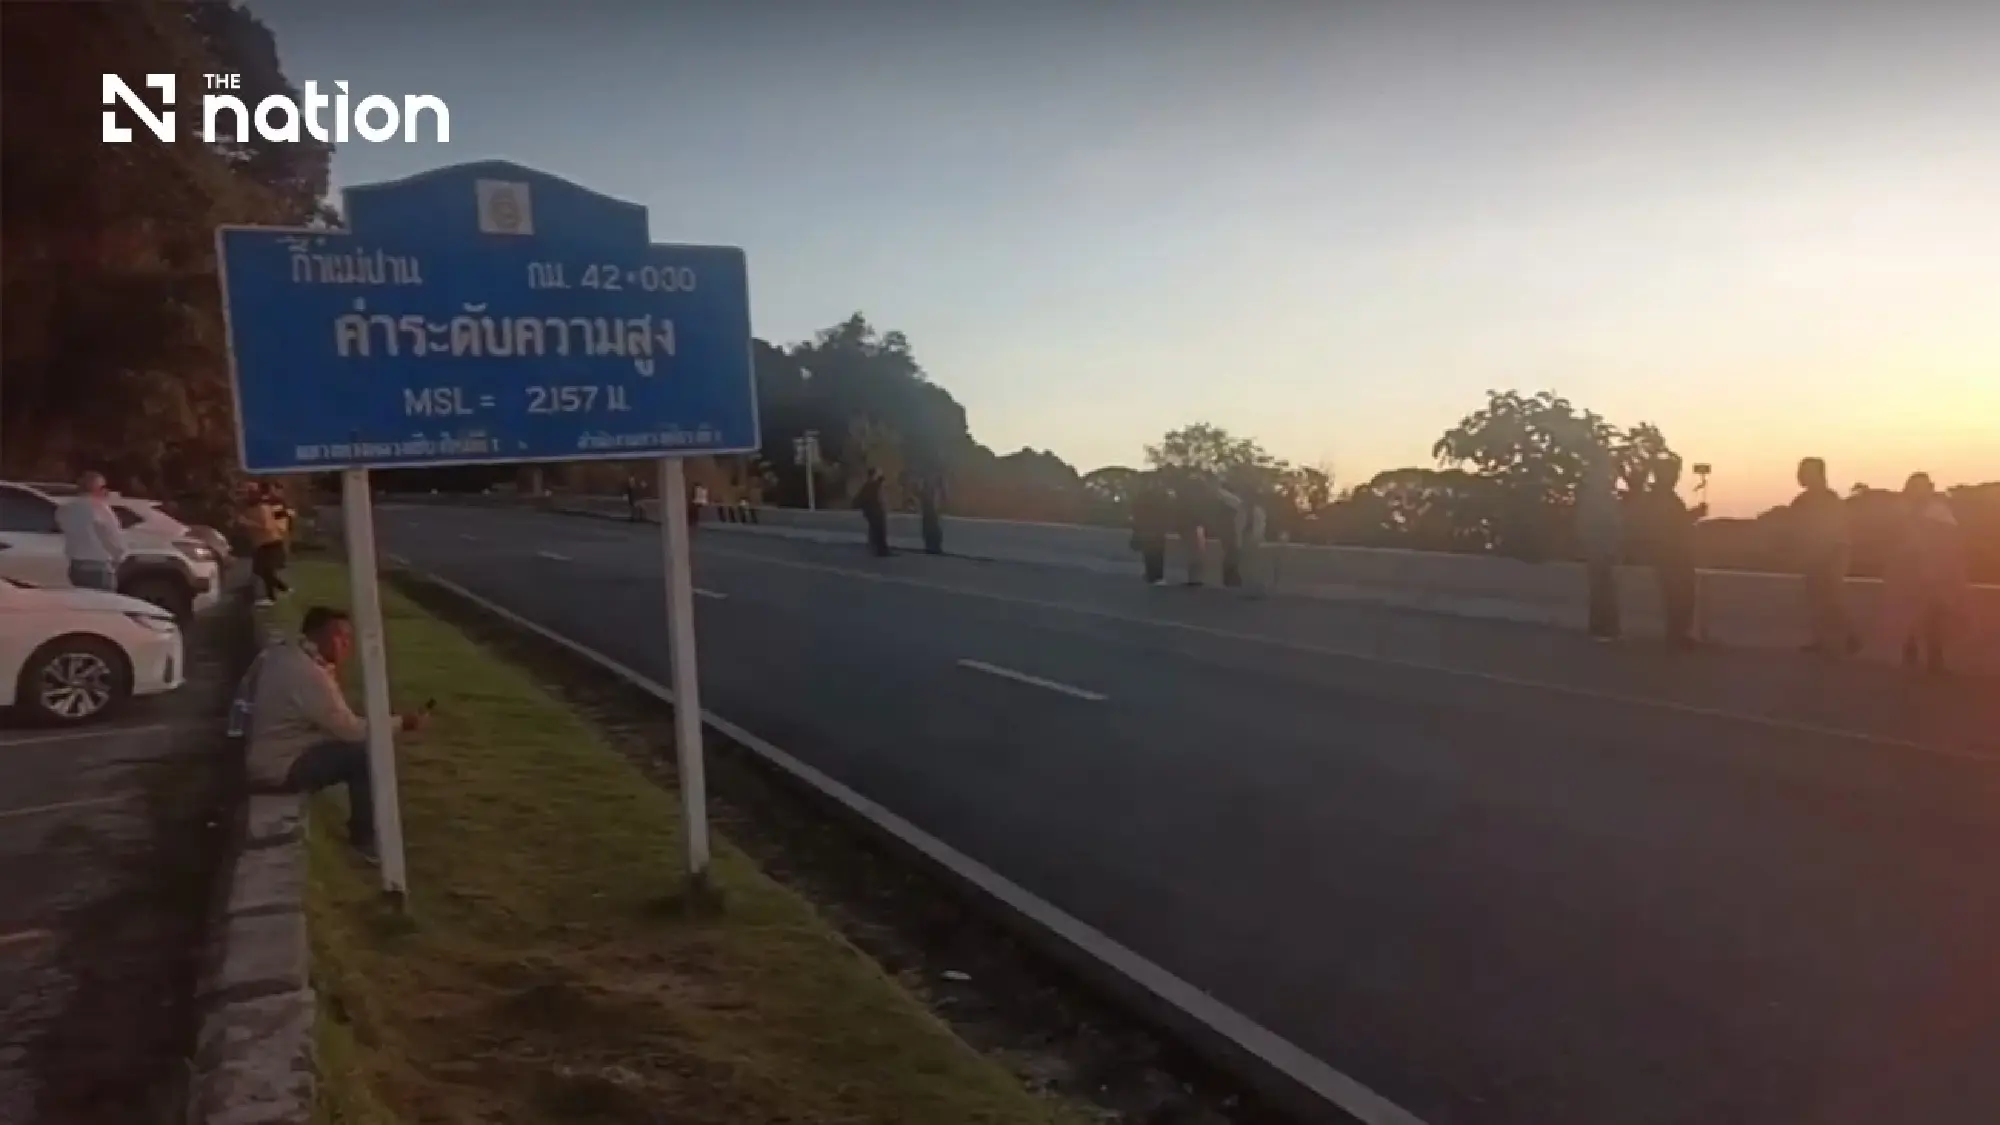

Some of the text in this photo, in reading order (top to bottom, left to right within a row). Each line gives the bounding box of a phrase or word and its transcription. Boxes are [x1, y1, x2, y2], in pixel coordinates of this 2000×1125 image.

[334, 296, 676, 377] ค่าระดับความสูง
[403, 387, 474, 416] MSL
